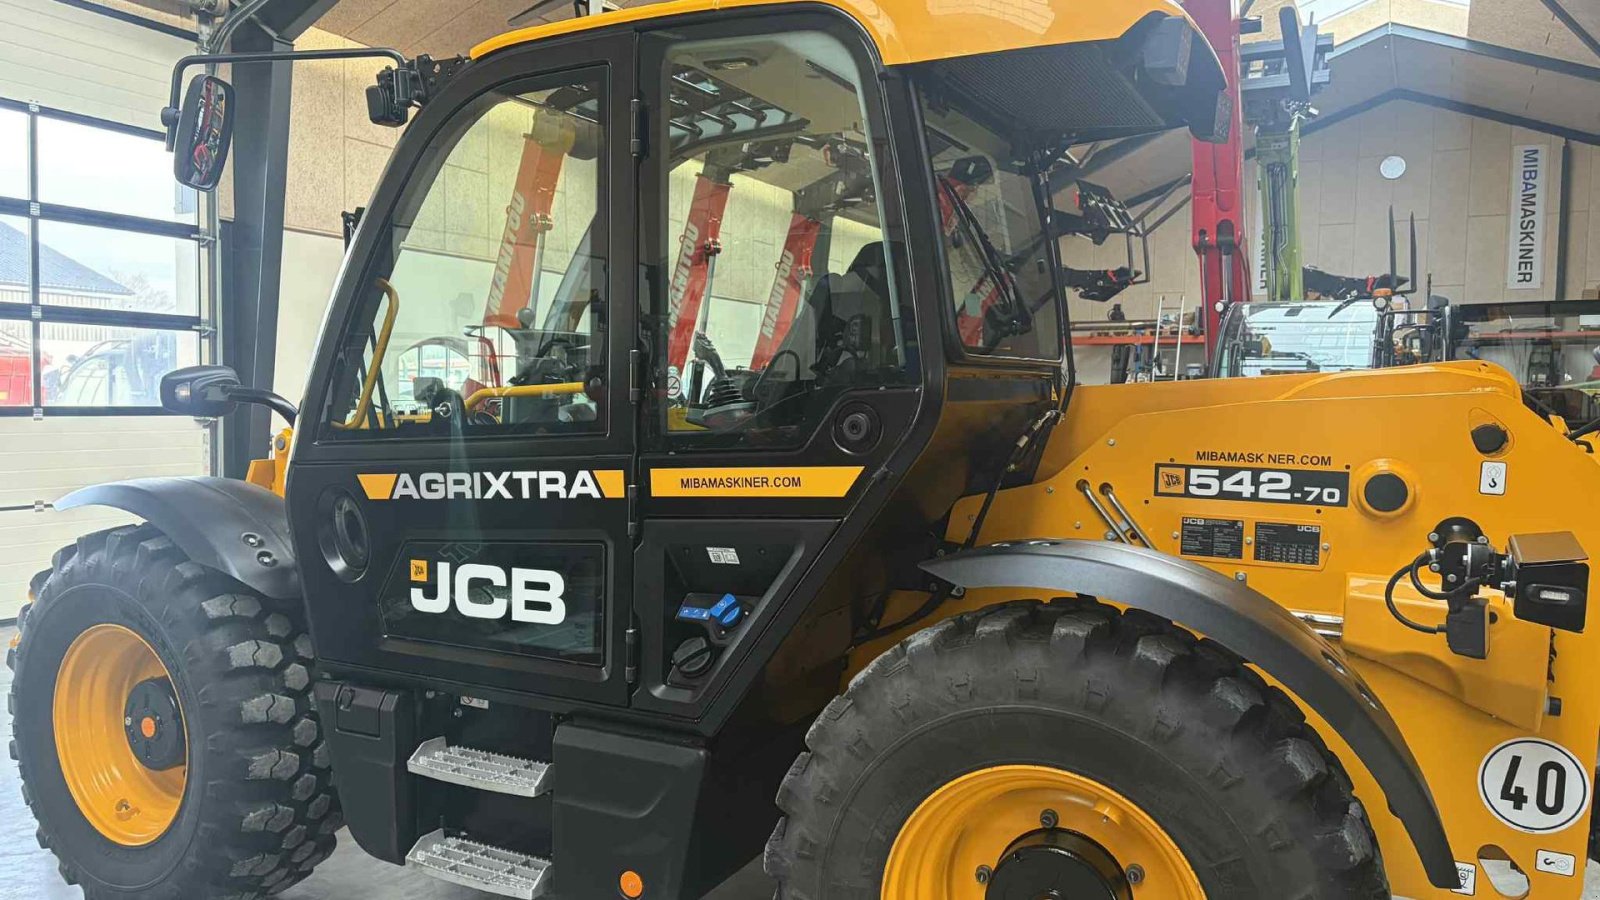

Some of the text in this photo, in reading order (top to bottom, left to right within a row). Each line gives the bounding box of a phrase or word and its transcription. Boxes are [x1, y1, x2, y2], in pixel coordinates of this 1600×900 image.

[1517, 148, 1539, 283] MIBAMASKINER
[487, 191, 525, 314] MANITOU
[761, 248, 795, 339] MANITOU
[391, 470, 602, 500] AGRIXTRA
[680, 476, 802, 489] MIBAMASKINER.COM
[1183, 517, 1205, 525] JCB
[1297, 525, 1320, 533] JCB
[410, 562, 566, 625] JCB
[1500, 755, 1566, 815] 40
